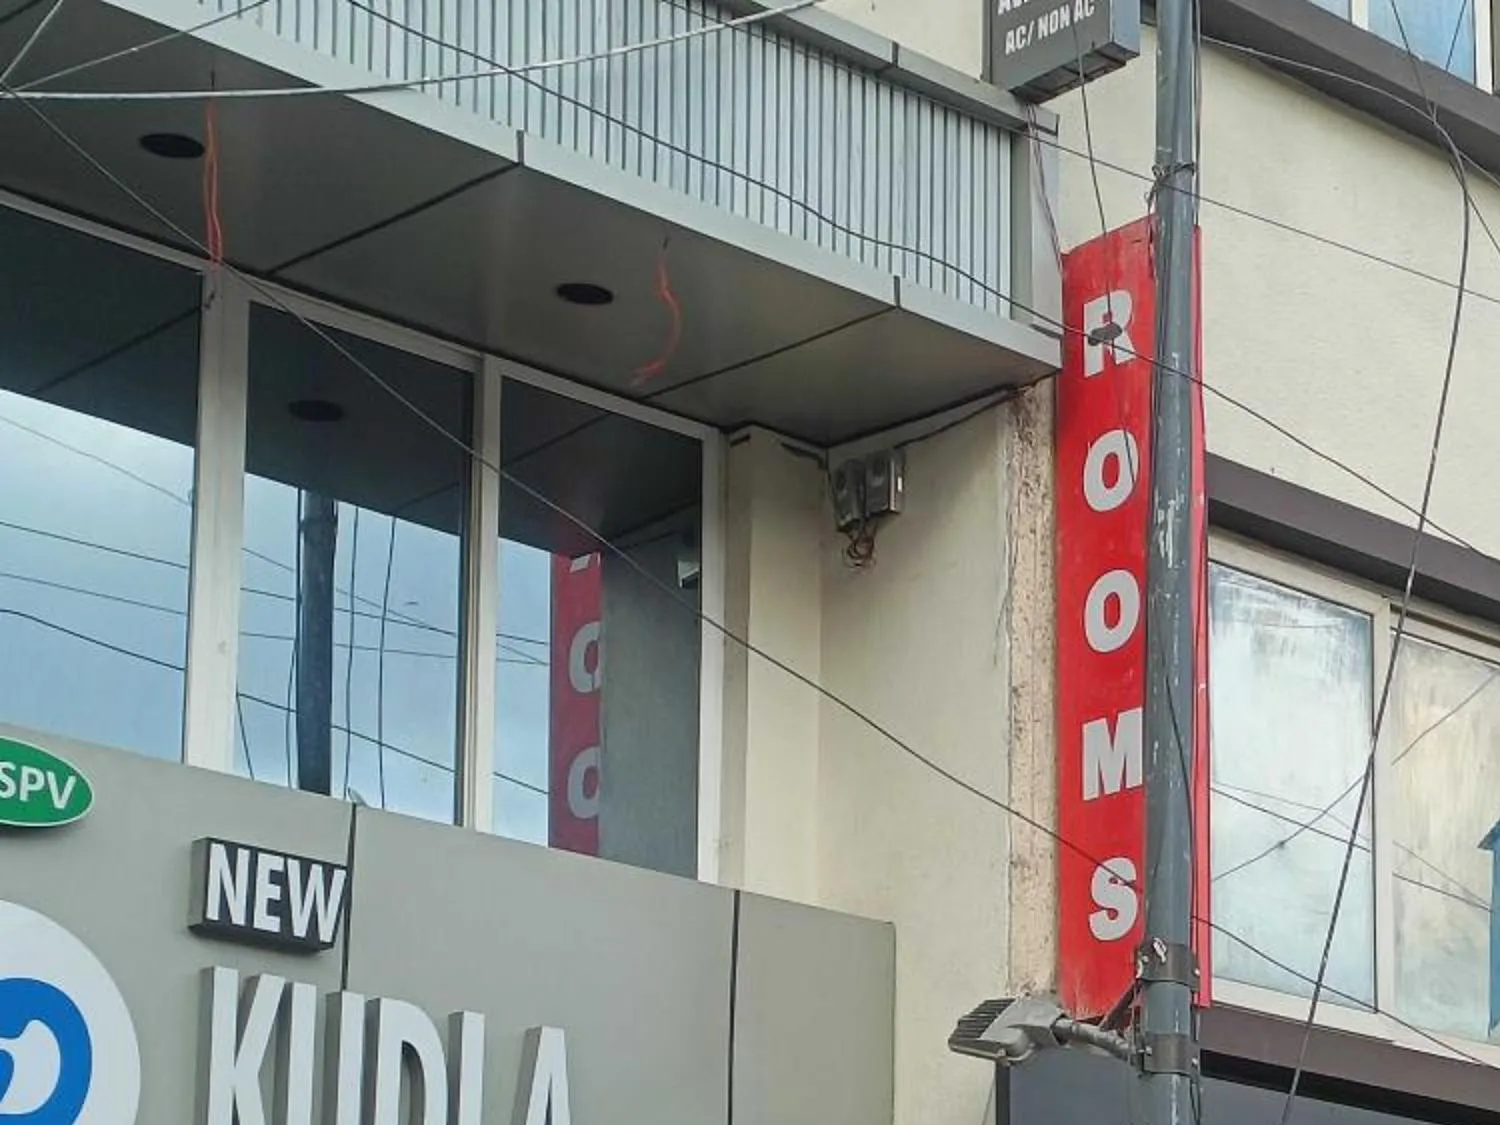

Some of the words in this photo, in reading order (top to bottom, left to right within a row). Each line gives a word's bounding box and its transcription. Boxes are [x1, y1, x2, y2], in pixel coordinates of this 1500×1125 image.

[1038, 4, 1070, 40] NON
[1074, 0, 1095, 23] AC
[1081, 289, 1143, 942] ROOMS
[206, 844, 347, 944] NEW
